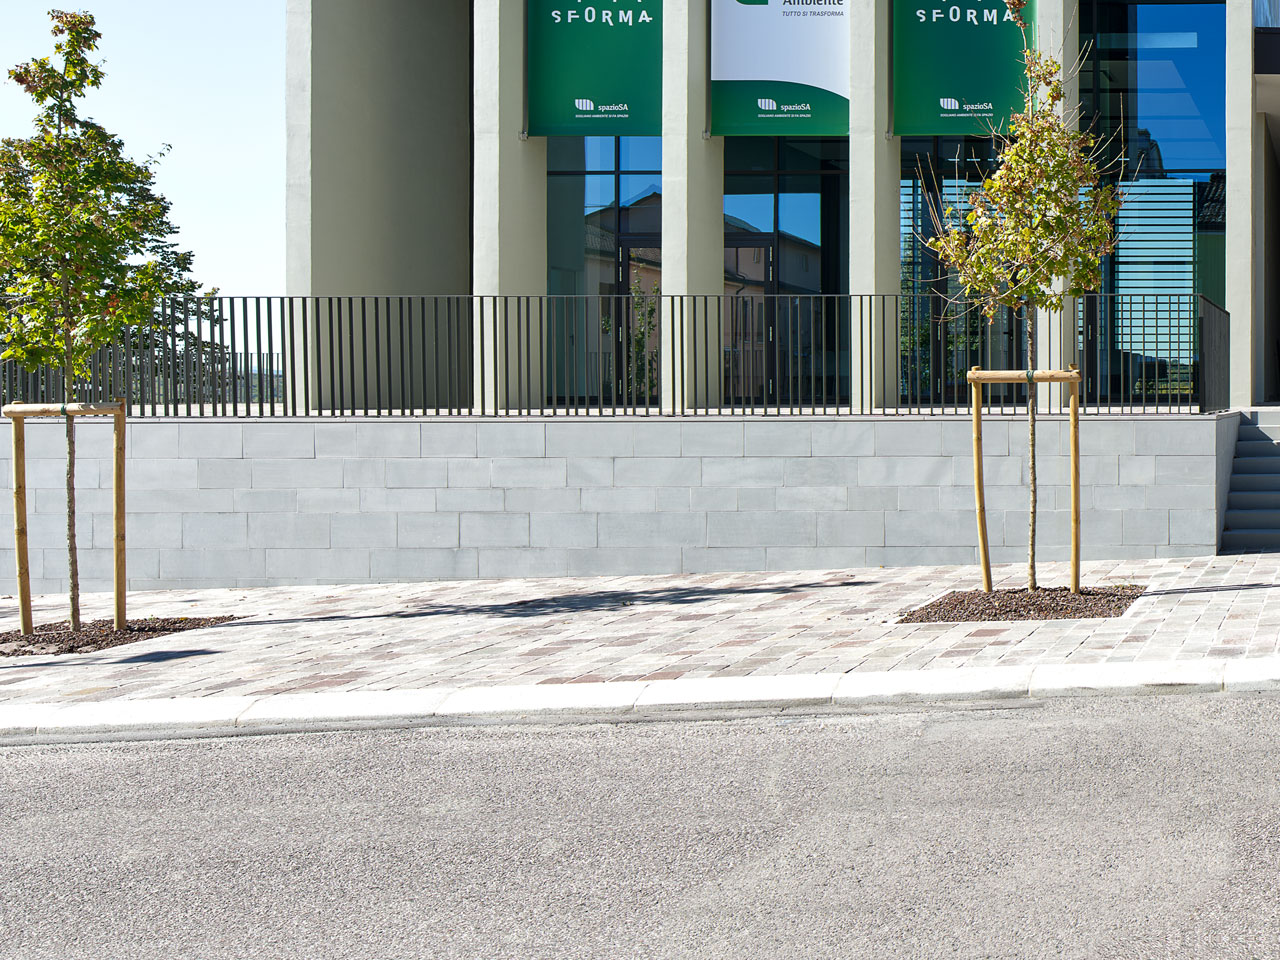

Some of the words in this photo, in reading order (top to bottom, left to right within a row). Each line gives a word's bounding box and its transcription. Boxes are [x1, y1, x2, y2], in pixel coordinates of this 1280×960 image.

[551, 6, 653, 26] SFORMA
[916, 5, 1015, 25] SFORMA
[598, 103, 629, 113] spazioSA
[780, 103, 811, 112] spazioSA
[962, 102, 993, 111] spazioSA
